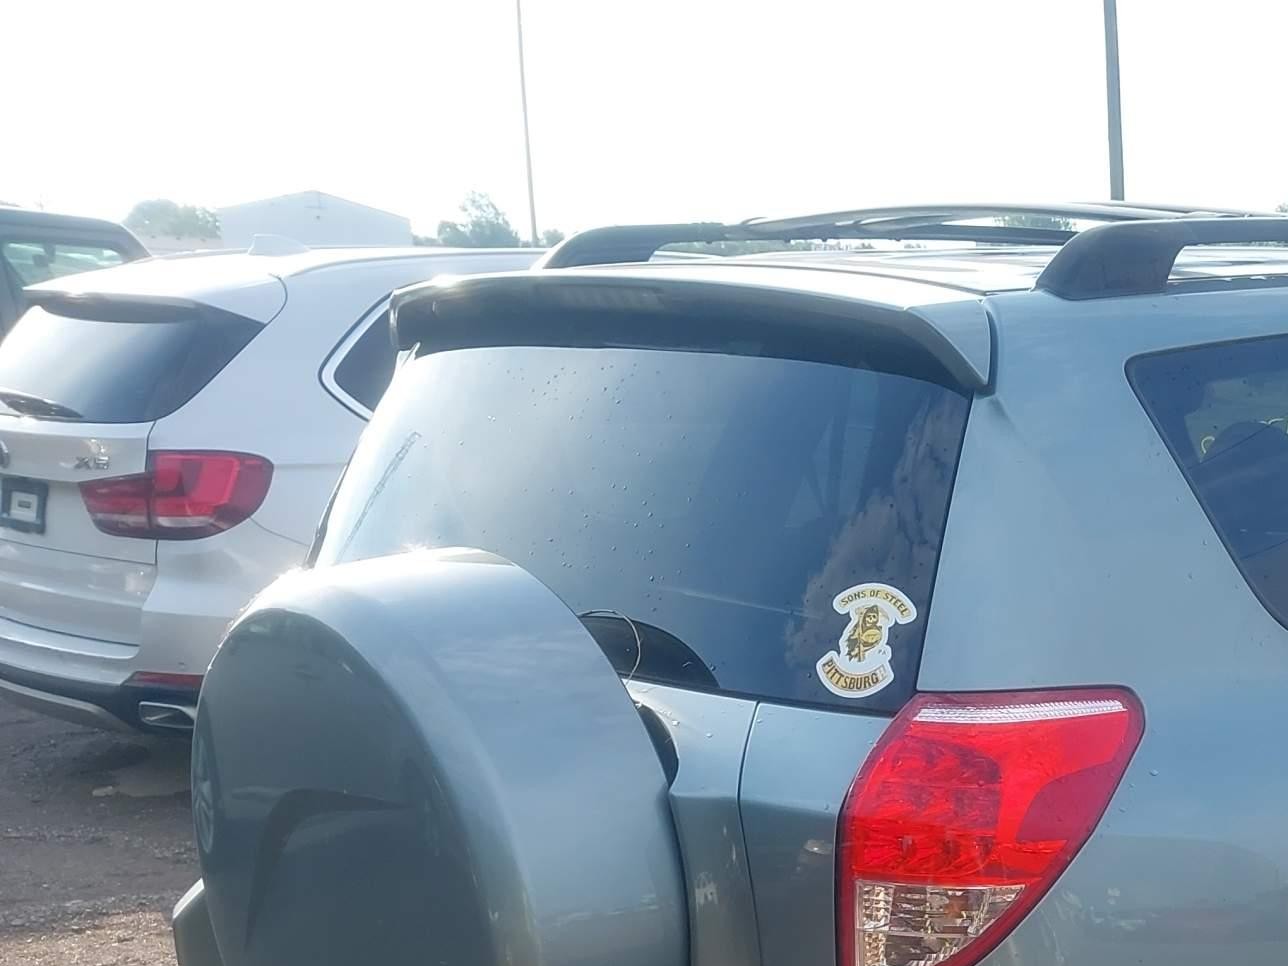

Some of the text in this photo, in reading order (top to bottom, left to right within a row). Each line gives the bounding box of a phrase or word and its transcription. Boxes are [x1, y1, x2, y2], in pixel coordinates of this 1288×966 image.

[840, 589, 910, 617] SONS OF STEEL
